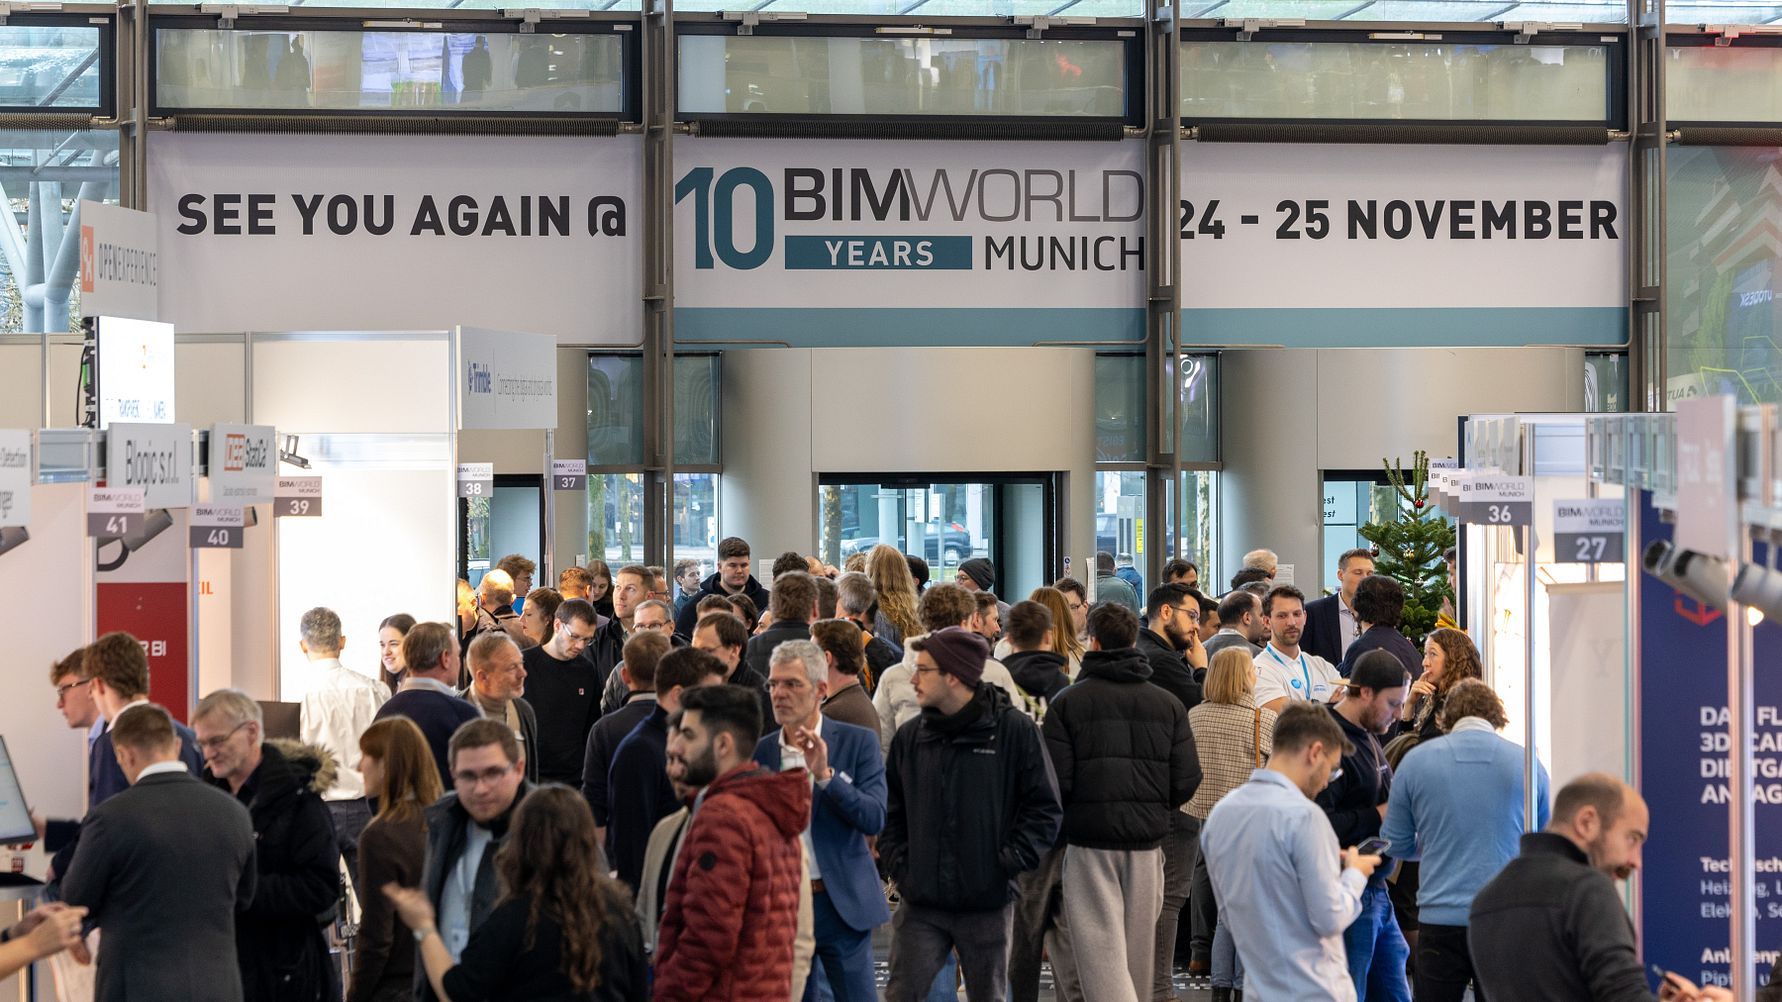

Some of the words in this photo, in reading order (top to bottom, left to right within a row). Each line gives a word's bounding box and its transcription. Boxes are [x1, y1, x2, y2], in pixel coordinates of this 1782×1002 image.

[784, 167, 1144, 223] BIMWORLD
[176, 193, 276, 236] SEE
[291, 194, 396, 237] YOU
[410, 195, 571, 238] AGAIN
[587, 195, 627, 238] @
[674, 167, 775, 270] 10
[1179, 199, 1226, 241] 24
[1240, 213, 1260, 225] -
[1274, 199, 1330, 241] 25
[1347, 199, 1619, 241] NOVEMBER
[825, 240, 935, 267] YEARS
[985, 235, 1145, 271] MUNICH
[125, 439, 158, 497] Blogic
[465, 483, 482, 495] 38
[561, 478, 576, 488] 37
[289, 500, 310, 515] 39
[1488, 505, 1512, 523] 36
[105, 516, 129, 534] 41
[206, 529, 230, 545] 40
[1575, 536, 1608, 561] 27
